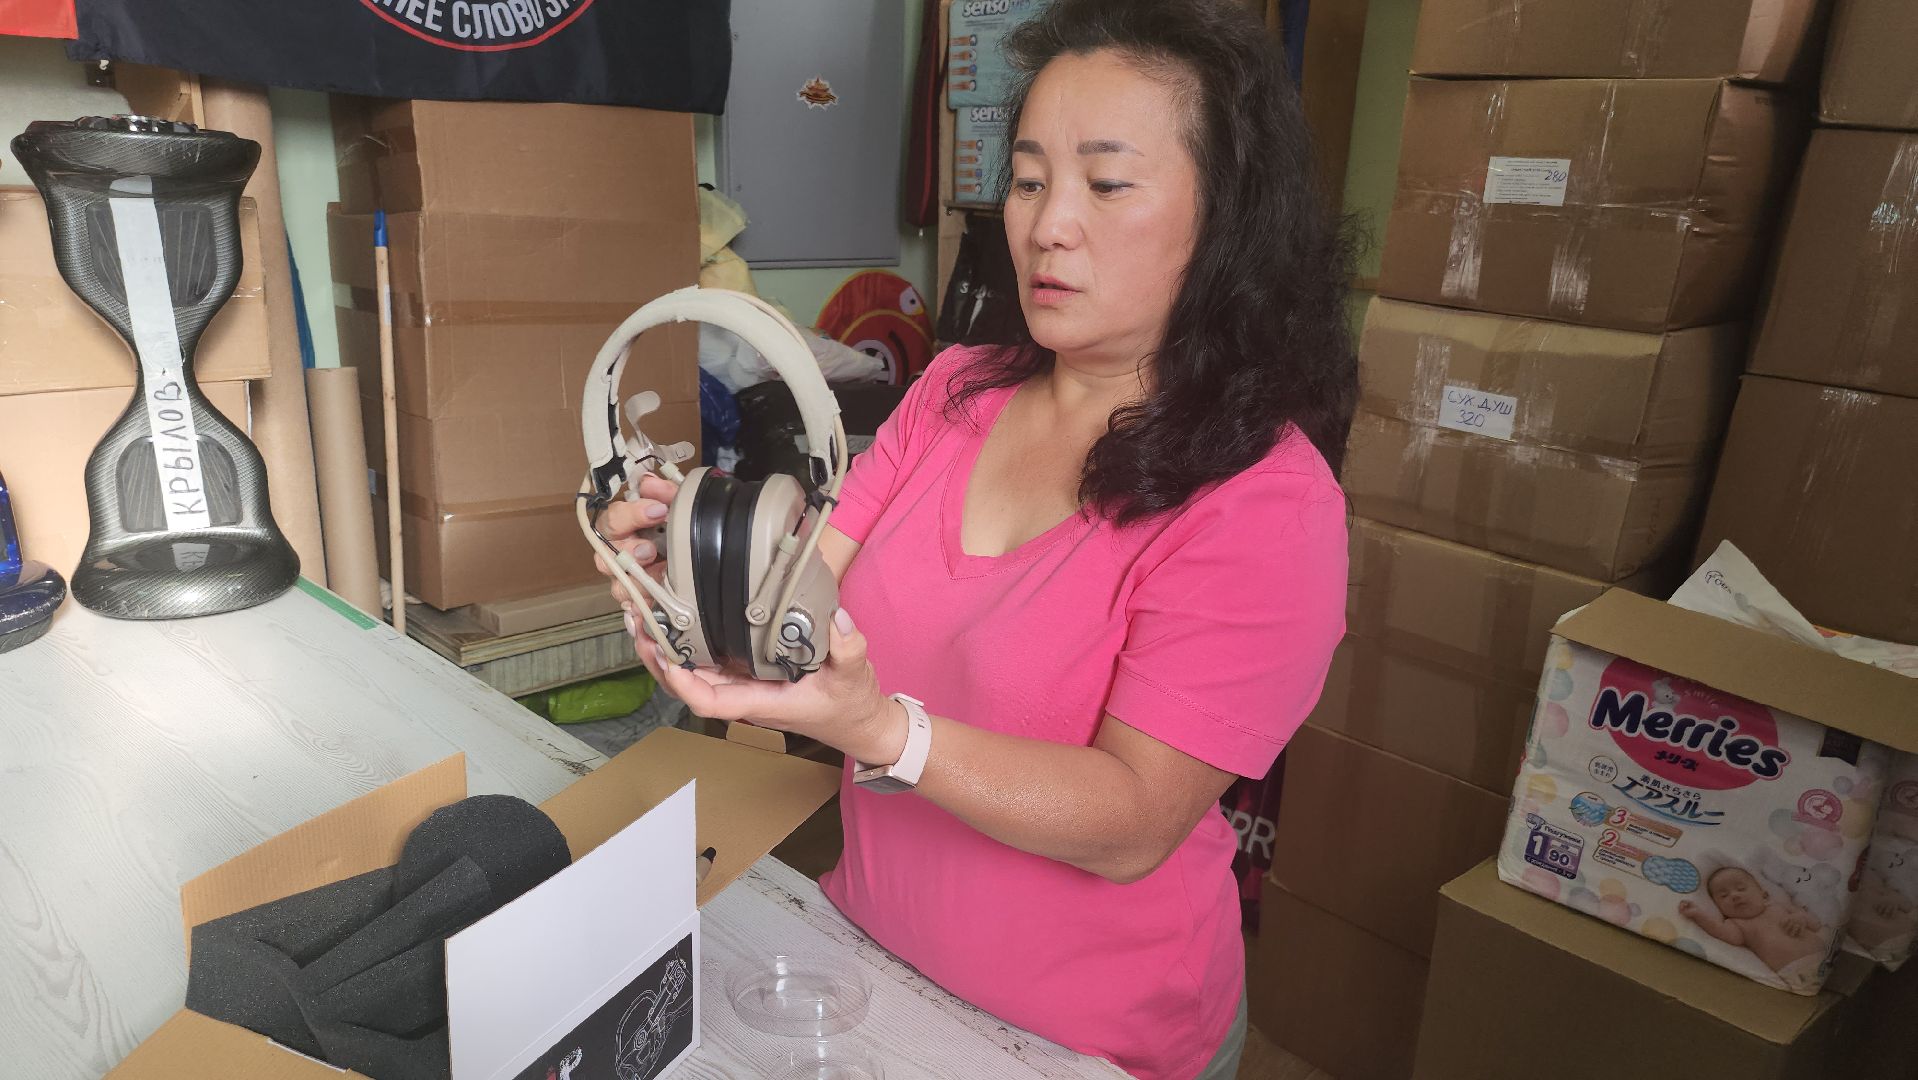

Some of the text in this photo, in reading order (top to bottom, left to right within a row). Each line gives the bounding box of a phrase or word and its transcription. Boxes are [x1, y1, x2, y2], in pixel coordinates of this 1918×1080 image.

[452, 0, 546, 40] СЛОВО
[1544, 170, 1567, 183] 280
[1455, 409, 1485, 428] 320
[154, 381, 207, 516] КРЫЛОВ
[1591, 688, 1787, 778] Merries
[1613, 776, 1726, 820] エアスルー
[1640, 774, 1702, 801] 素肌さらさら
[1611, 809, 1628, 825] 3
[1532, 834, 1544, 856] 1
[1603, 831, 1618, 847] 2
[1549, 849, 1570, 866] 90
